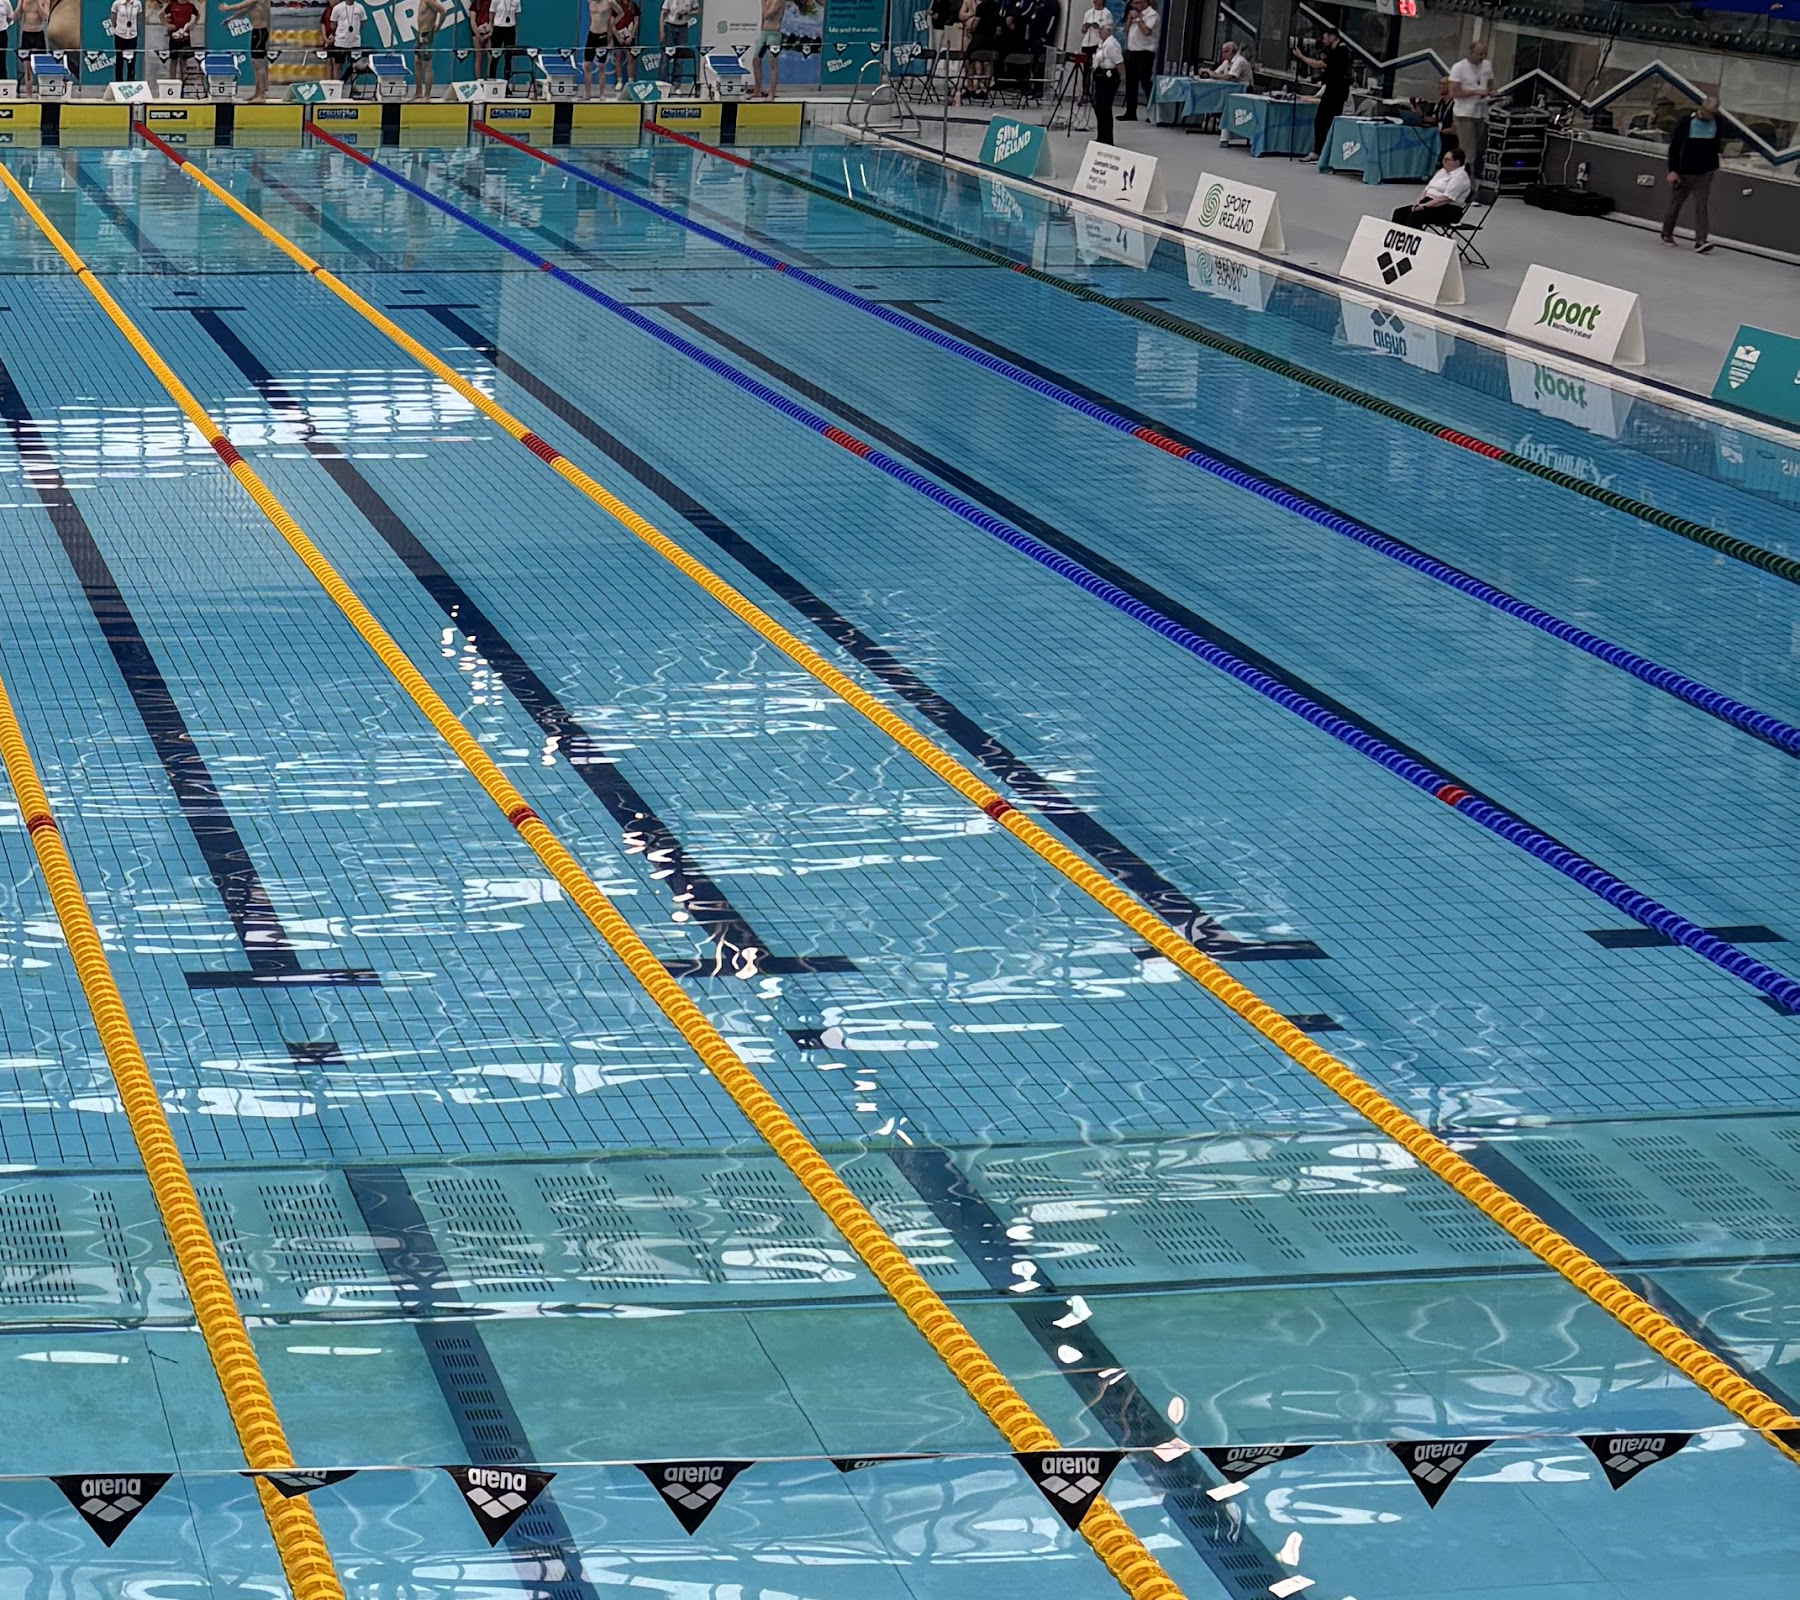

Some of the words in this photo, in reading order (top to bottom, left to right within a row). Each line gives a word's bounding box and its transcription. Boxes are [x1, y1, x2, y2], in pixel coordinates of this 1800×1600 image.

[2, 87, 9, 97] 5
[167, 88, 174, 96] 6
[329, 88, 334, 97] 7
[492, 87, 498, 95] 8
[996, 123, 1020, 146] SWIM
[993, 130, 1031, 164] IRELAND
[1224, 194, 1252, 214] SPORT
[1218, 210, 1254, 234] IRELAND
[1383, 229, 1422, 256] arena
[1227, 1445, 1285, 1462] arena
[1413, 1441, 1468, 1462] arena
[1608, 1437, 1667, 1455] arena
[664, 1465, 724, 1483] arena
[1042, 1456, 1100, 1475] arena
[80, 1478, 142, 1497] arena
[468, 1466, 527, 1492] arena
